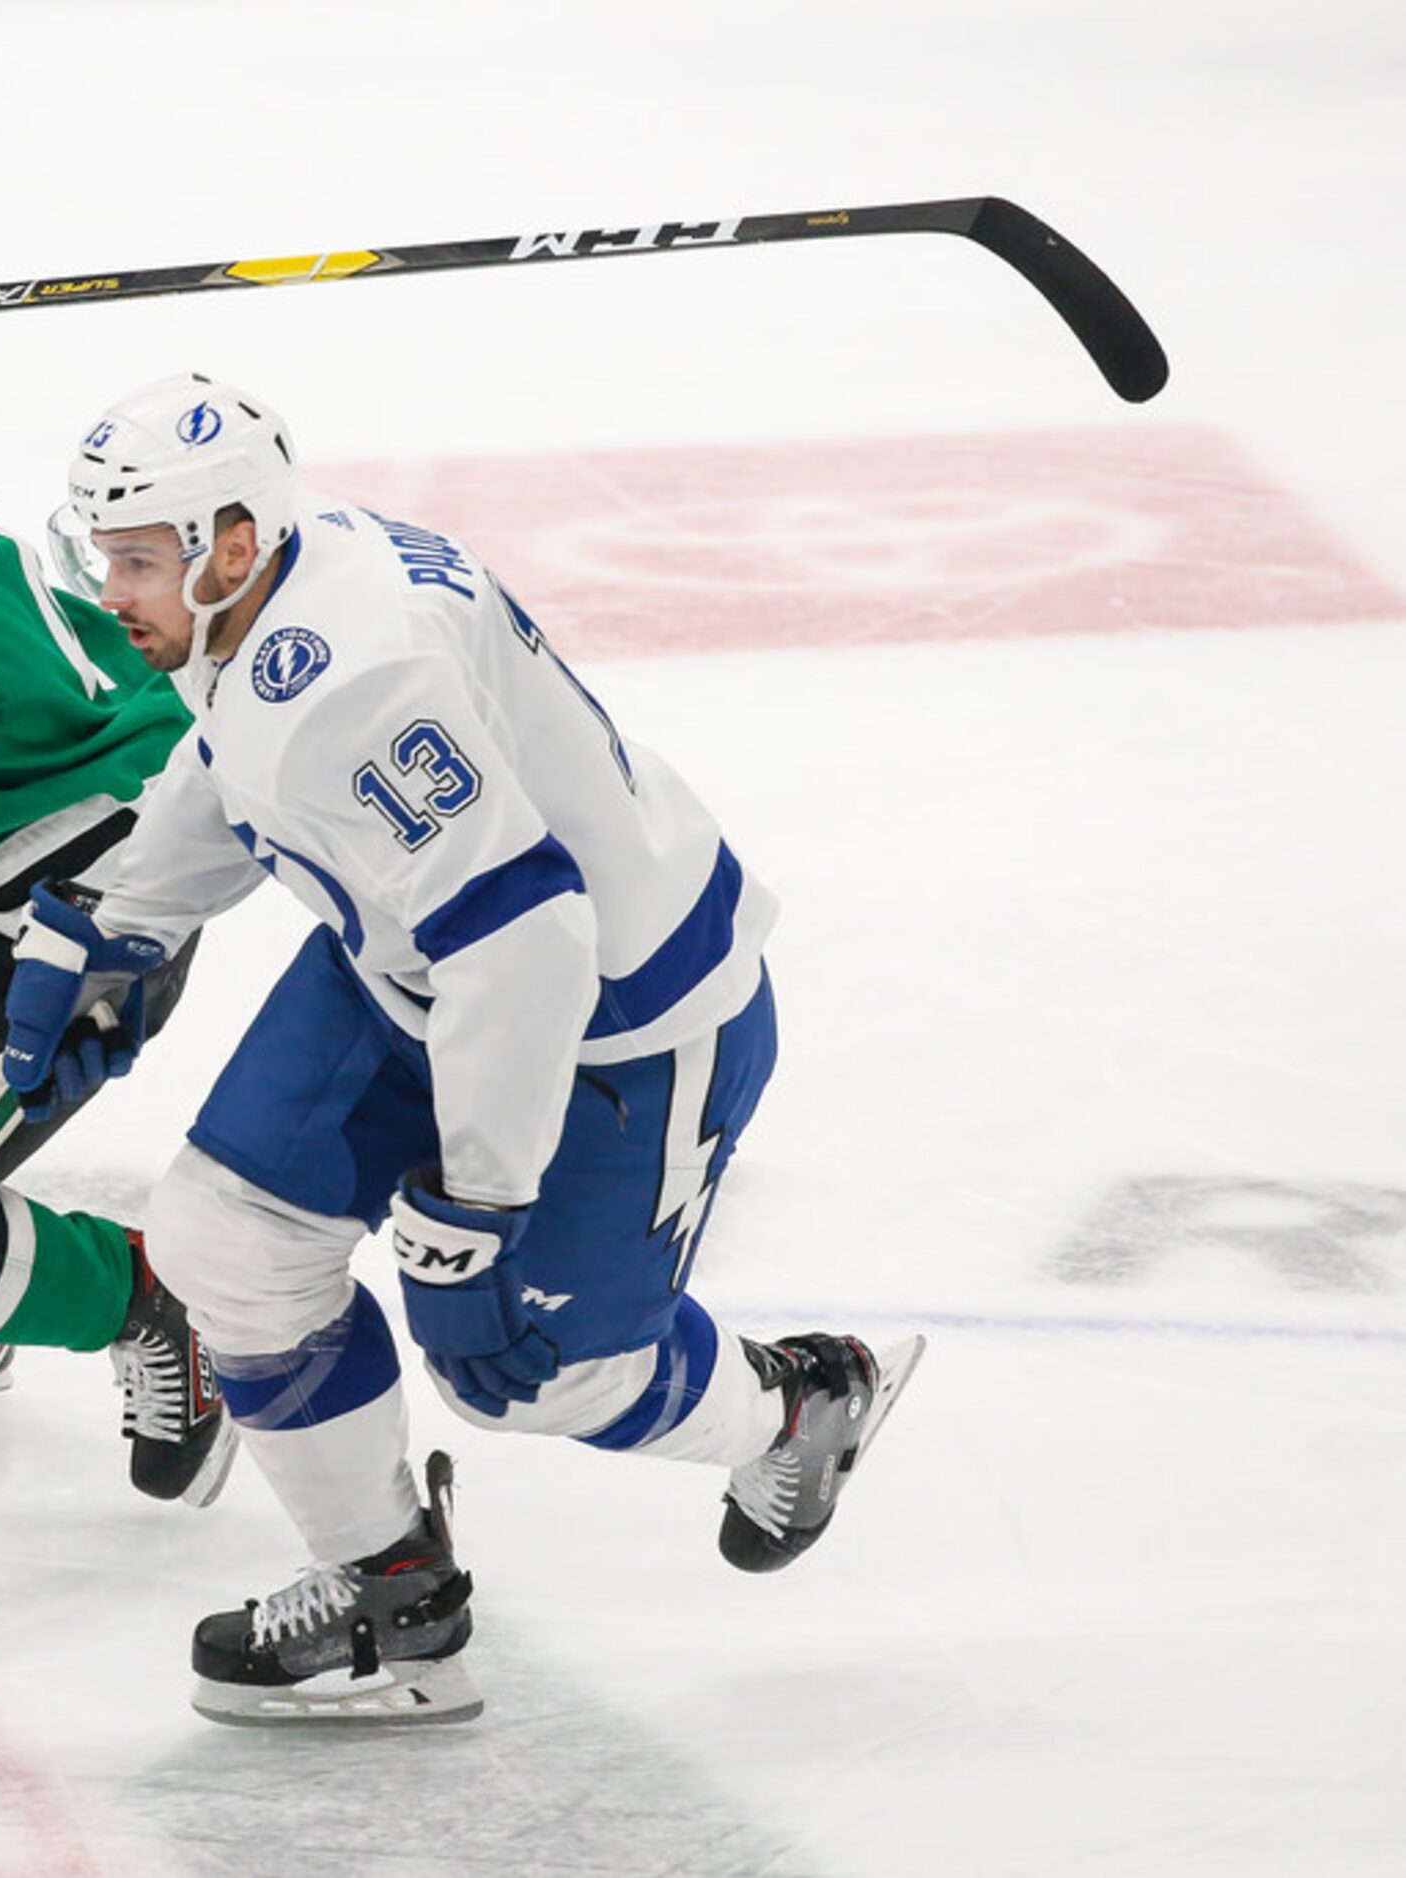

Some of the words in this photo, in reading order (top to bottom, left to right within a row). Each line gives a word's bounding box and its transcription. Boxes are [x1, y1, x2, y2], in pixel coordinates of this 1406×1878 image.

[508, 219, 744, 261] CCM
[40, 277, 120, 296] SUPER
[353, 719, 483, 854] 13
